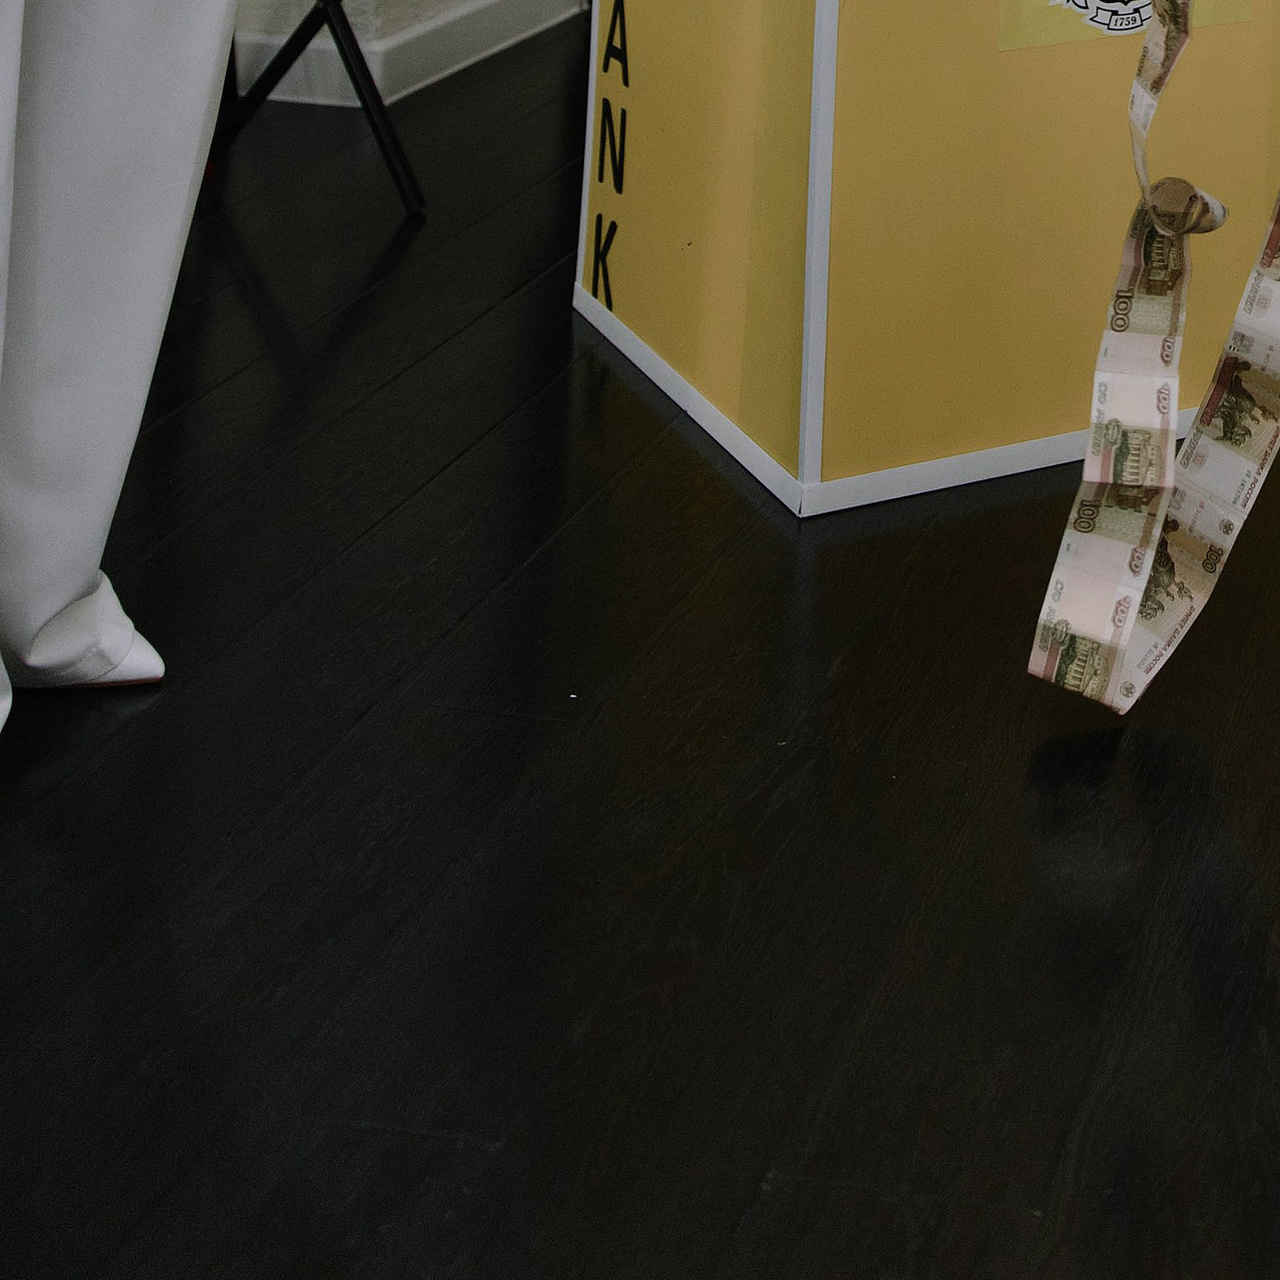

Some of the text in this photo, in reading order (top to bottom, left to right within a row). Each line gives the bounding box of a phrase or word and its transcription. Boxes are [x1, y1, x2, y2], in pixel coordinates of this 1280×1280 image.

[1113, 15, 1138, 28] 1759
[1111, 289, 1133, 333] 100
[1240, 475, 1260, 510] РОССИИ
[1074, 498, 1102, 534] 100
[1128, 546, 1146, 578] 100
[1202, 543, 1224, 574] 100
[1112, 594, 1131, 629] 100
[1177, 604, 1196, 628] БИЛЕТ
[1161, 627, 1181, 652] БАНКА
[1143, 649, 1164, 676] РОССИИ
